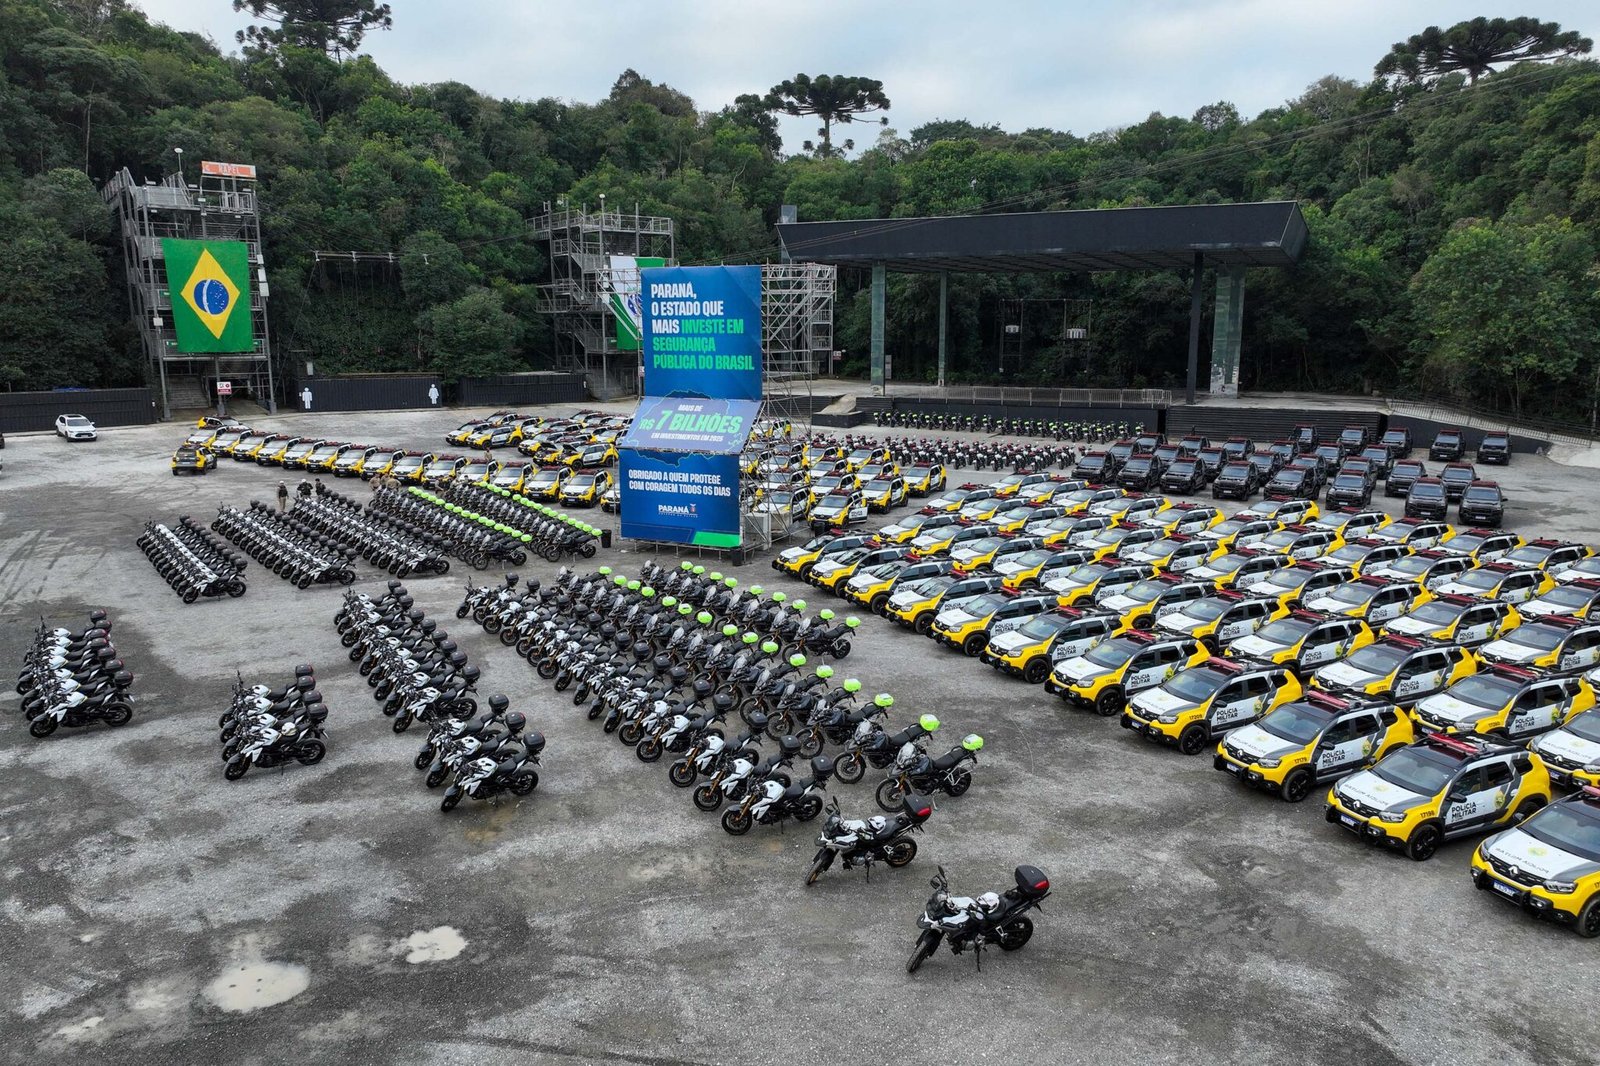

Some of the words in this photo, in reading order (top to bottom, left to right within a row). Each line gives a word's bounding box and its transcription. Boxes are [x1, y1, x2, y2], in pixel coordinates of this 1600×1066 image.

[650, 281, 696, 299] PARANÁ,
[652, 302, 658, 316] O
[660, 301, 700, 316] ESTADO
[702, 300, 724, 317] QUE
[652, 319, 679, 334] MAIS
[681, 319, 725, 334] INVESTE
[727, 318, 744, 334] EM
[653, 336, 716, 353] SEGURANÇA
[654, 353, 697, 369] PÚBLICA
[699, 354, 713, 369] DO
[715, 355, 755, 370] BRASIL
[655, 410, 672, 430] 7
[669, 412, 743, 434] BILHÕES
[628, 469, 660, 480] OBRIGADO
[663, 472, 668, 481] A
[669, 472, 688, 483] QUEM
[690, 474, 721, 484] PROTEGE
[629, 480, 644, 490] COM
[645, 482, 678, 493] CORAGEM
[679, 484, 701, 494] TODOS
[703, 486, 712, 496] OS
[714, 486, 731, 496] DIAS
[658, 504, 689, 513] PARANÁ
[1217, 712, 1238, 721] MILITAR
[1323, 755, 1346, 765] MILITAR
[1452, 808, 1476, 819] MILITAR
